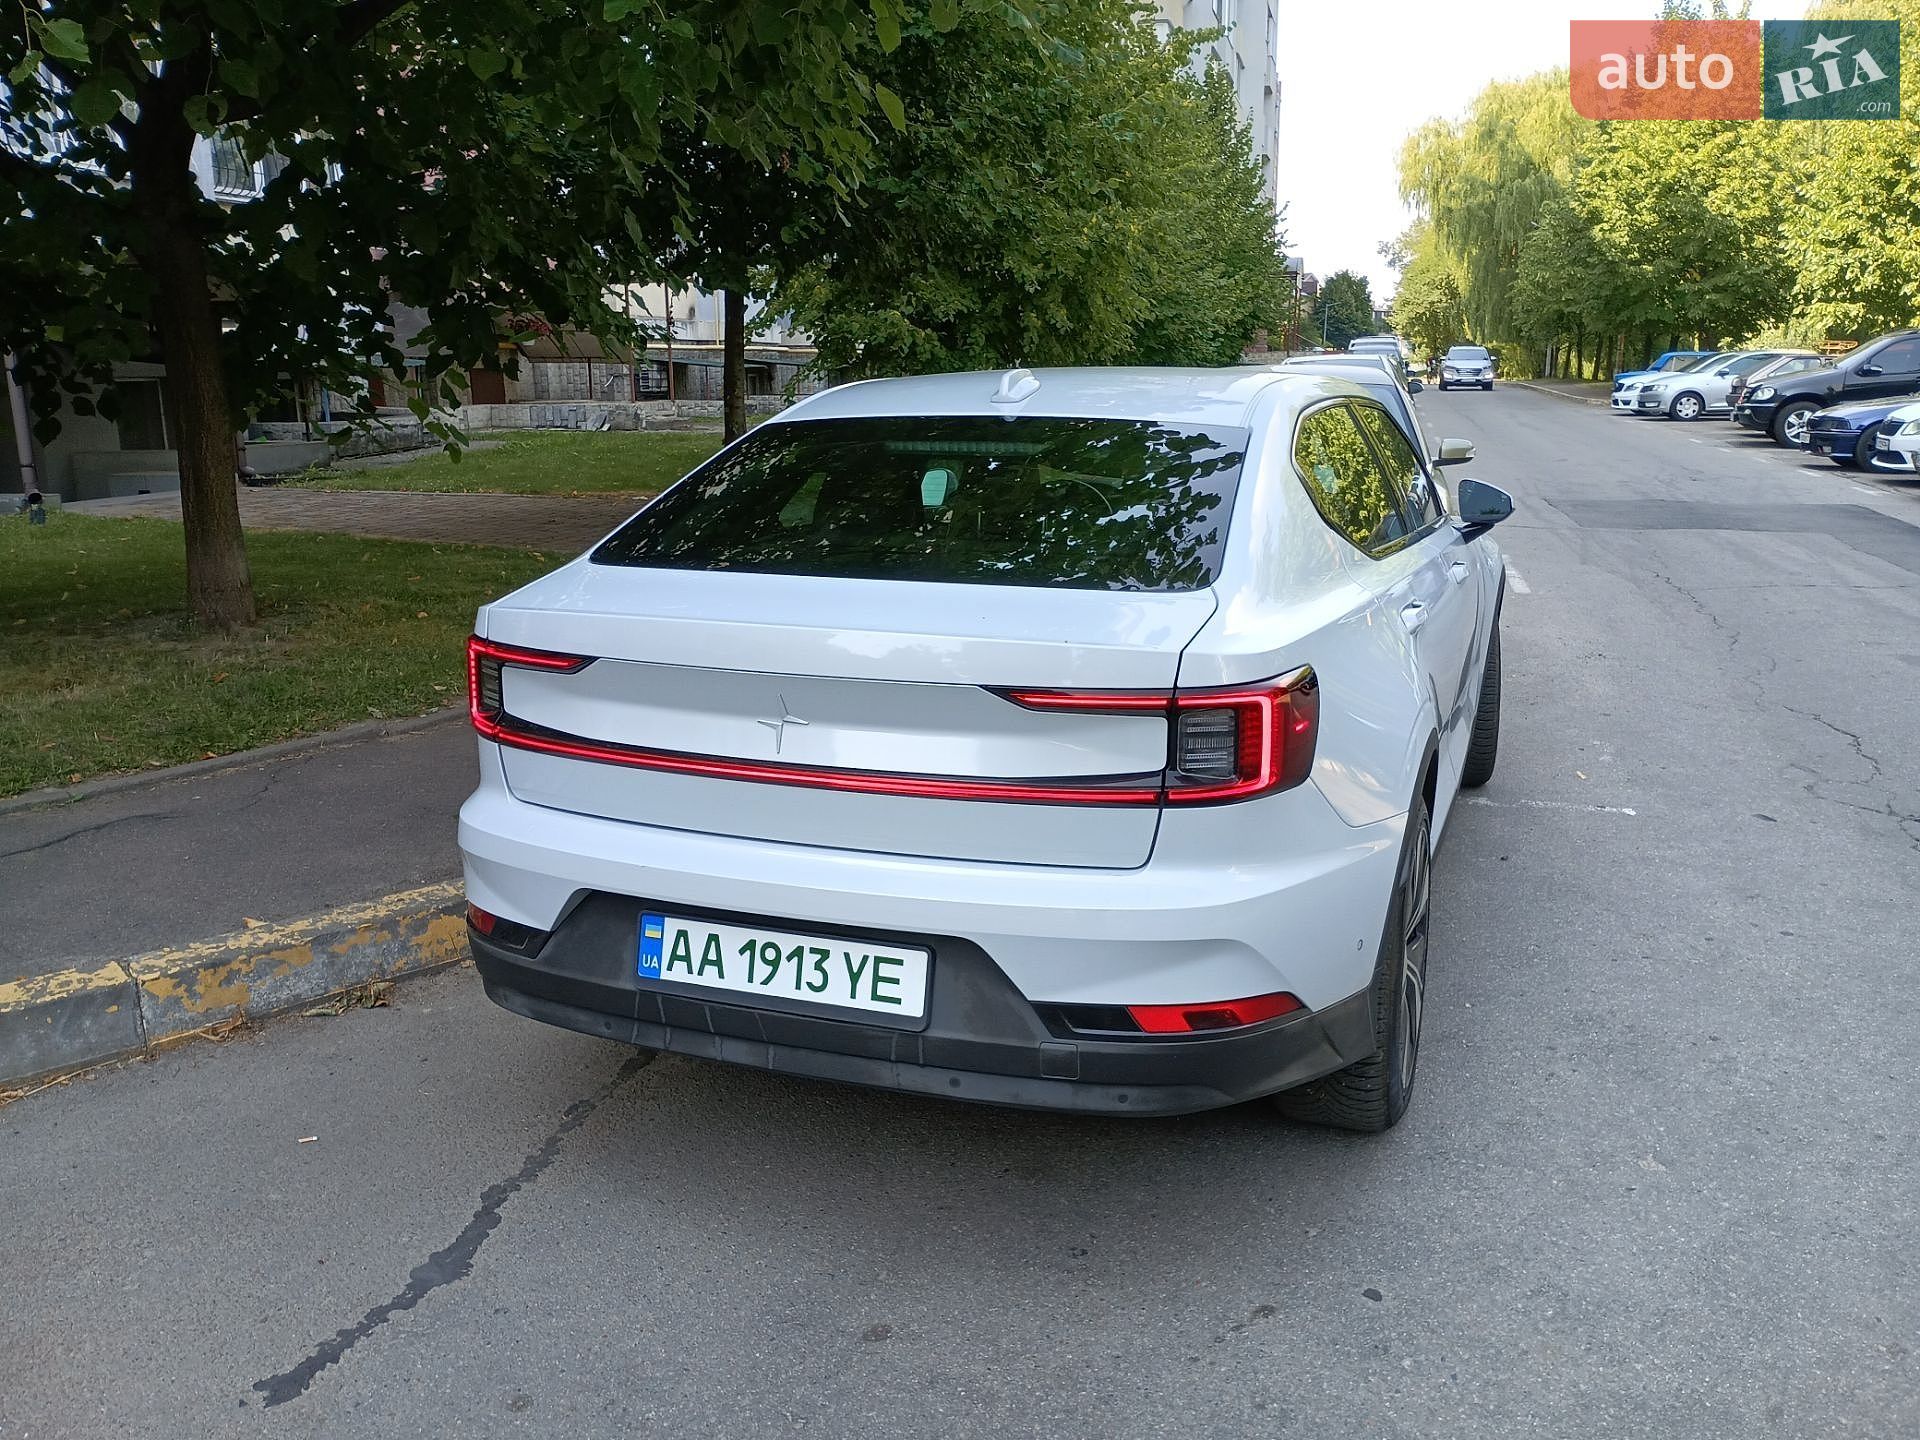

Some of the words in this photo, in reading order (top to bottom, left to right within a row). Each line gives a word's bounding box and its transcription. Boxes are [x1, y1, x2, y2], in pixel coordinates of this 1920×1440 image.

[642, 953, 659, 969] UA
[666, 929, 725, 979] AA
[738, 939, 830, 993] 1913
[843, 951, 904, 1005] YE
